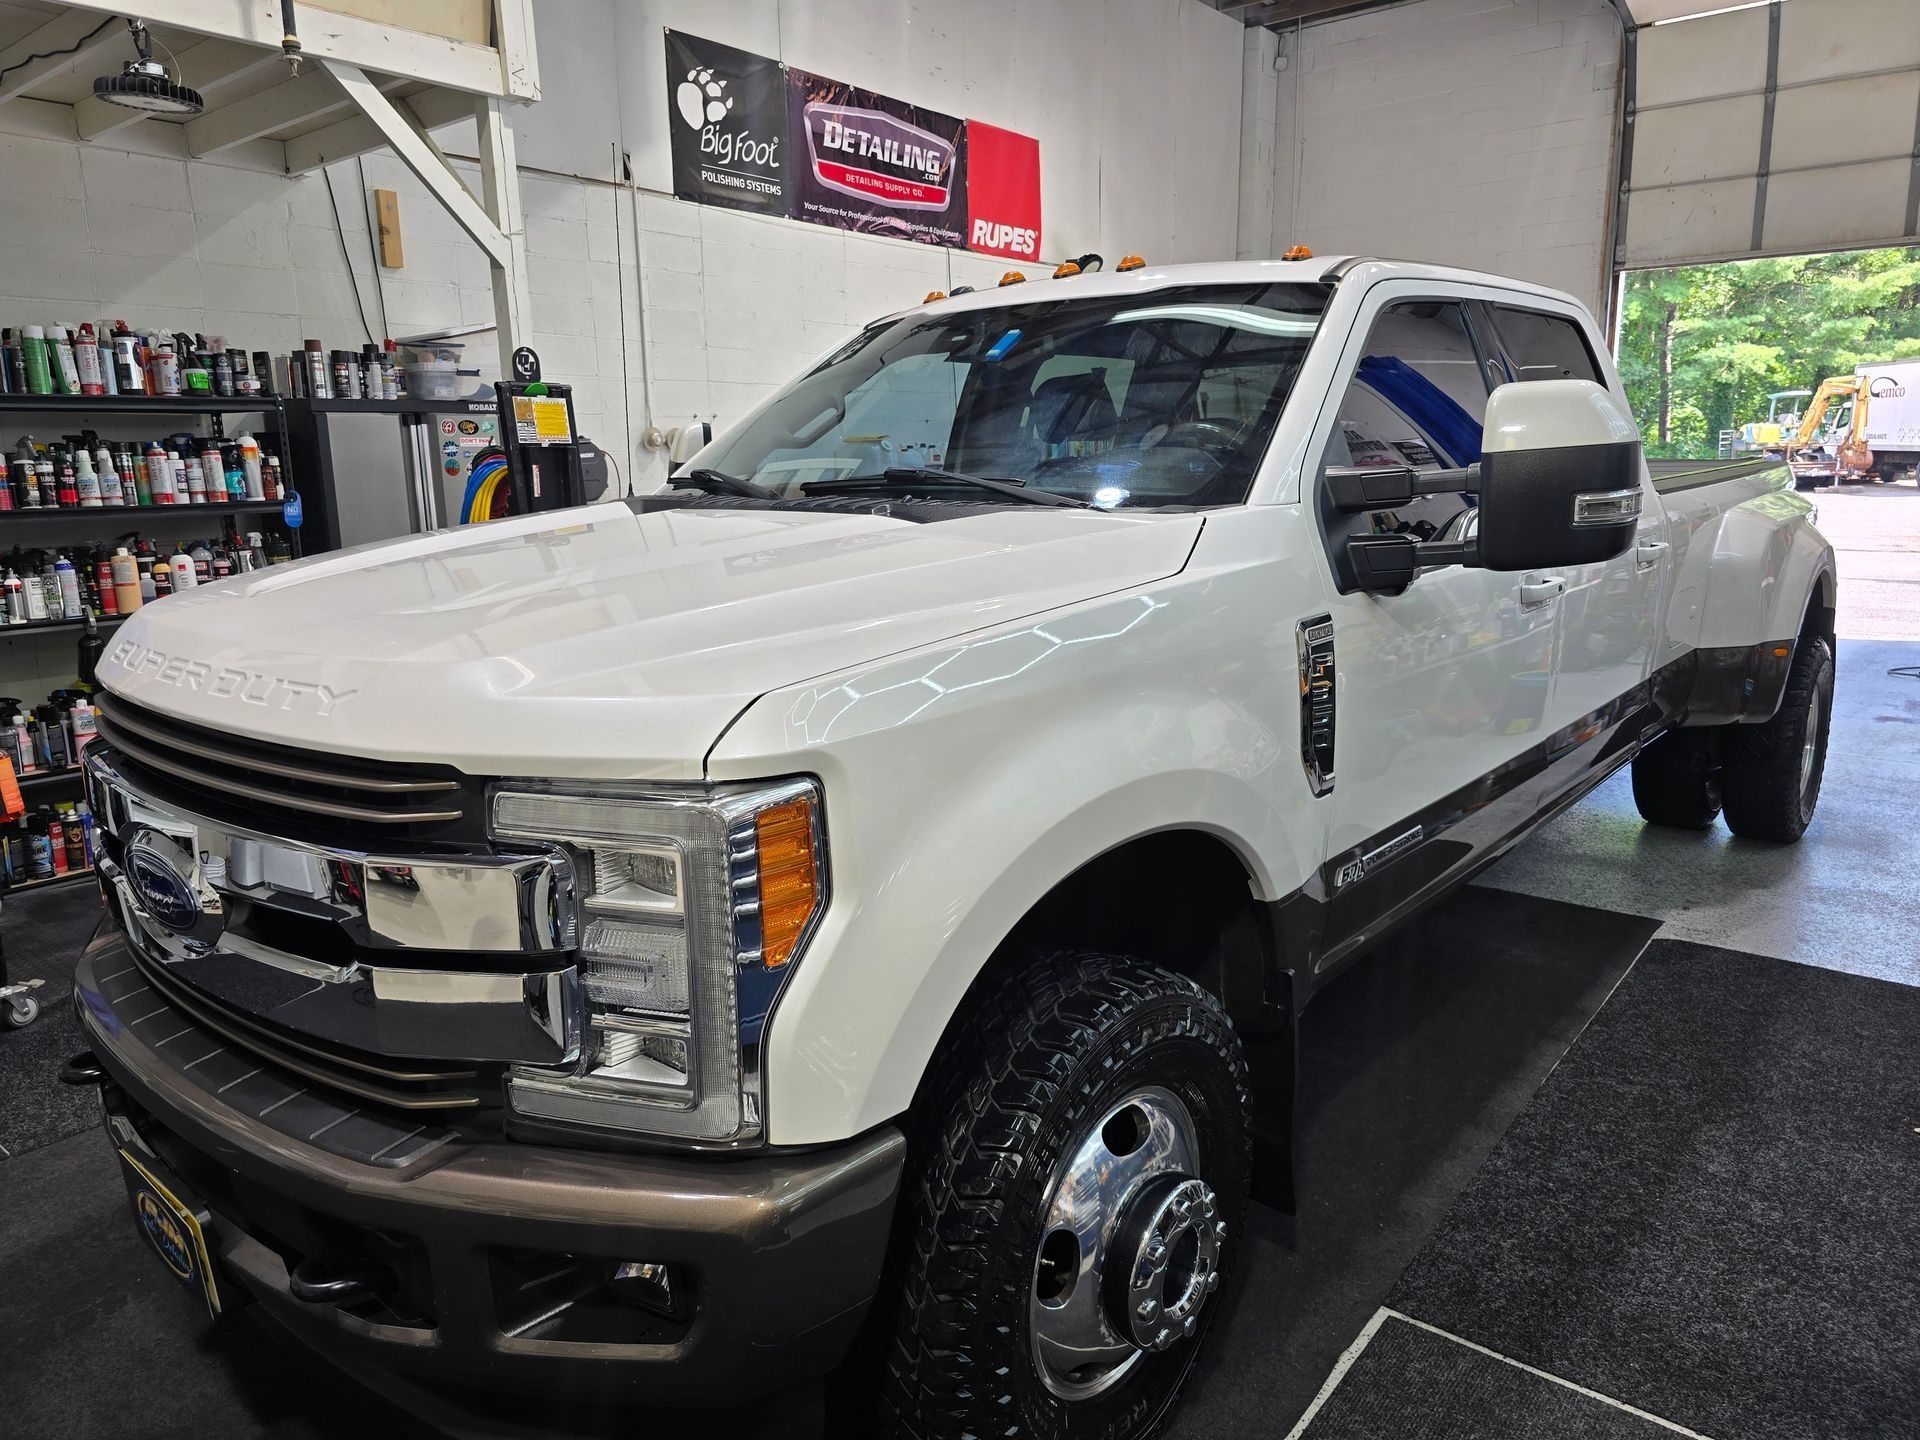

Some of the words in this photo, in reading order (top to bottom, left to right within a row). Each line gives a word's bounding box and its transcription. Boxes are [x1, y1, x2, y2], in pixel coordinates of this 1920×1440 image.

[822, 118, 940, 174] DETAILING
[701, 170, 746, 189] POLISHING
[746, 179, 782, 196] SYSTEMS
[845, 173, 883, 189] DETAILING
[885, 182, 911, 195] SUPPLY
[912, 189, 925, 198] CO.
[804, 201, 819, 211] Your
[819, 204, 840, 215] Source
[840, 208, 848, 217] for
[847, 210, 884, 223] Professional
[971, 218, 1036, 255] RUPES
[468, 403, 498, 411] KOBALT
[110, 639, 211, 691] SUPER
[207, 667, 360, 717] DUTY
